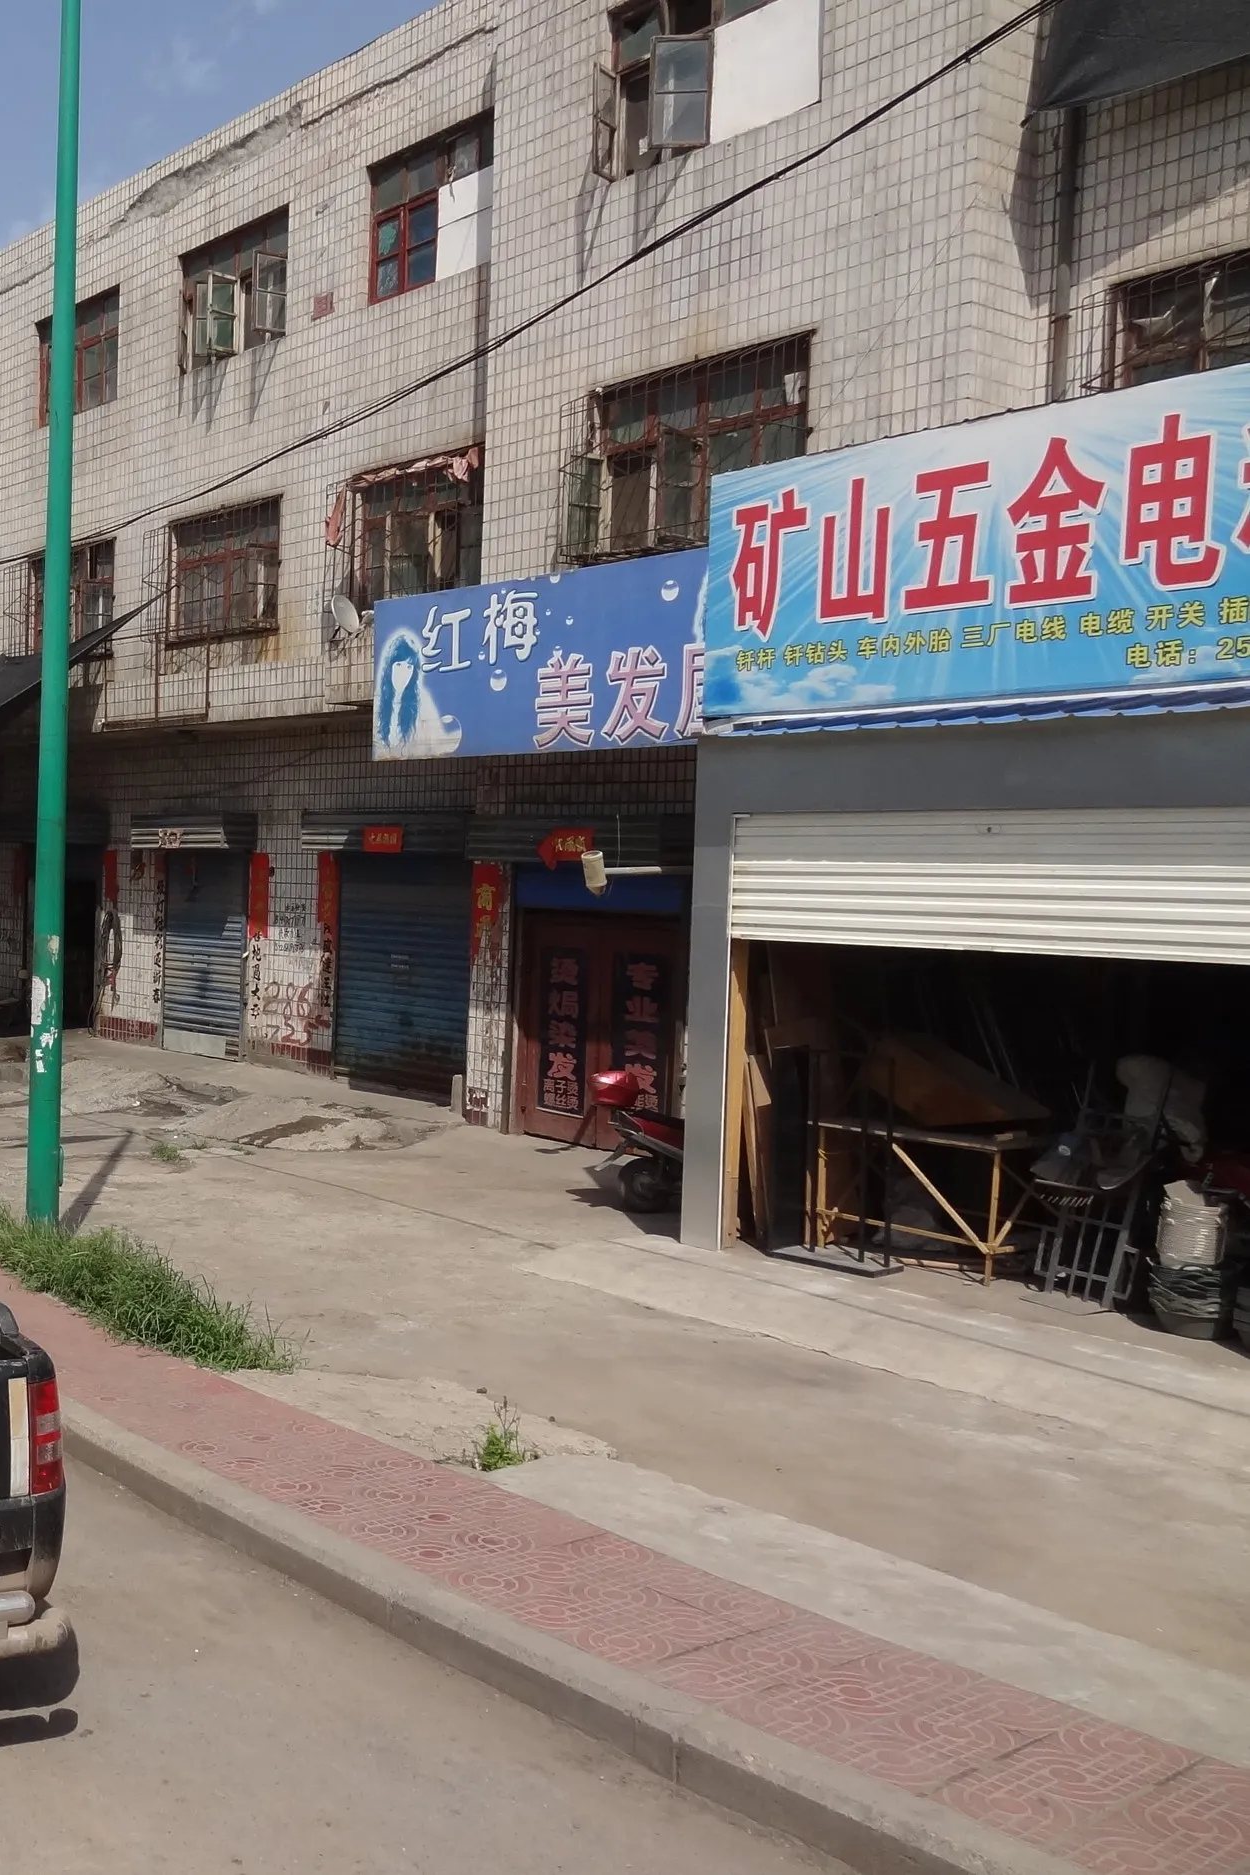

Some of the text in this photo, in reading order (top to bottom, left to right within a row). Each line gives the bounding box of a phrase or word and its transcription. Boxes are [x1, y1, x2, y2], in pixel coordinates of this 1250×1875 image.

[730, 411, 1250, 642] 矿山五金电
[421, 589, 539, 673] 红梅
[857, 628, 953, 659] 车内外胎
[960, 615, 1067, 648] 三厂电线
[1079, 607, 1135, 635] 电缆
[1146, 600, 1205, 631] 开关
